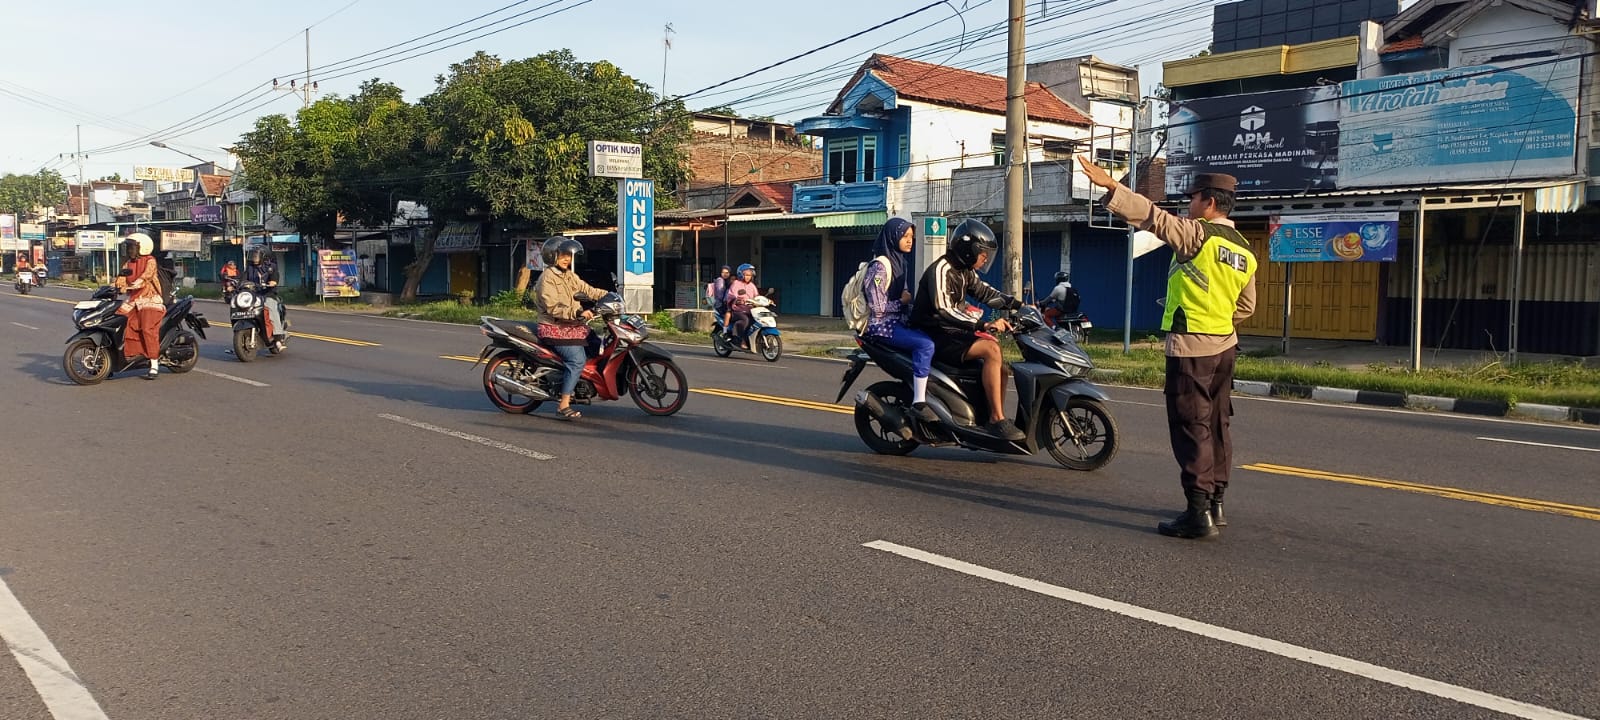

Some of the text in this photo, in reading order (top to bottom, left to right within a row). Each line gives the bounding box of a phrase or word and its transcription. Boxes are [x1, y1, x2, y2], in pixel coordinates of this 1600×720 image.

[1232, 131, 1271, 146] APM
[595, 144, 641, 155] OPTIK NUSA
[1206, 153, 1238, 161] AMANAH
[1239, 151, 1273, 159] PERKASA
[1275, 149, 1313, 157] MADINAH
[626, 181, 652, 198] OPTIK
[632, 199, 646, 263] NUSA
[1295, 227, 1323, 239] ESSE
